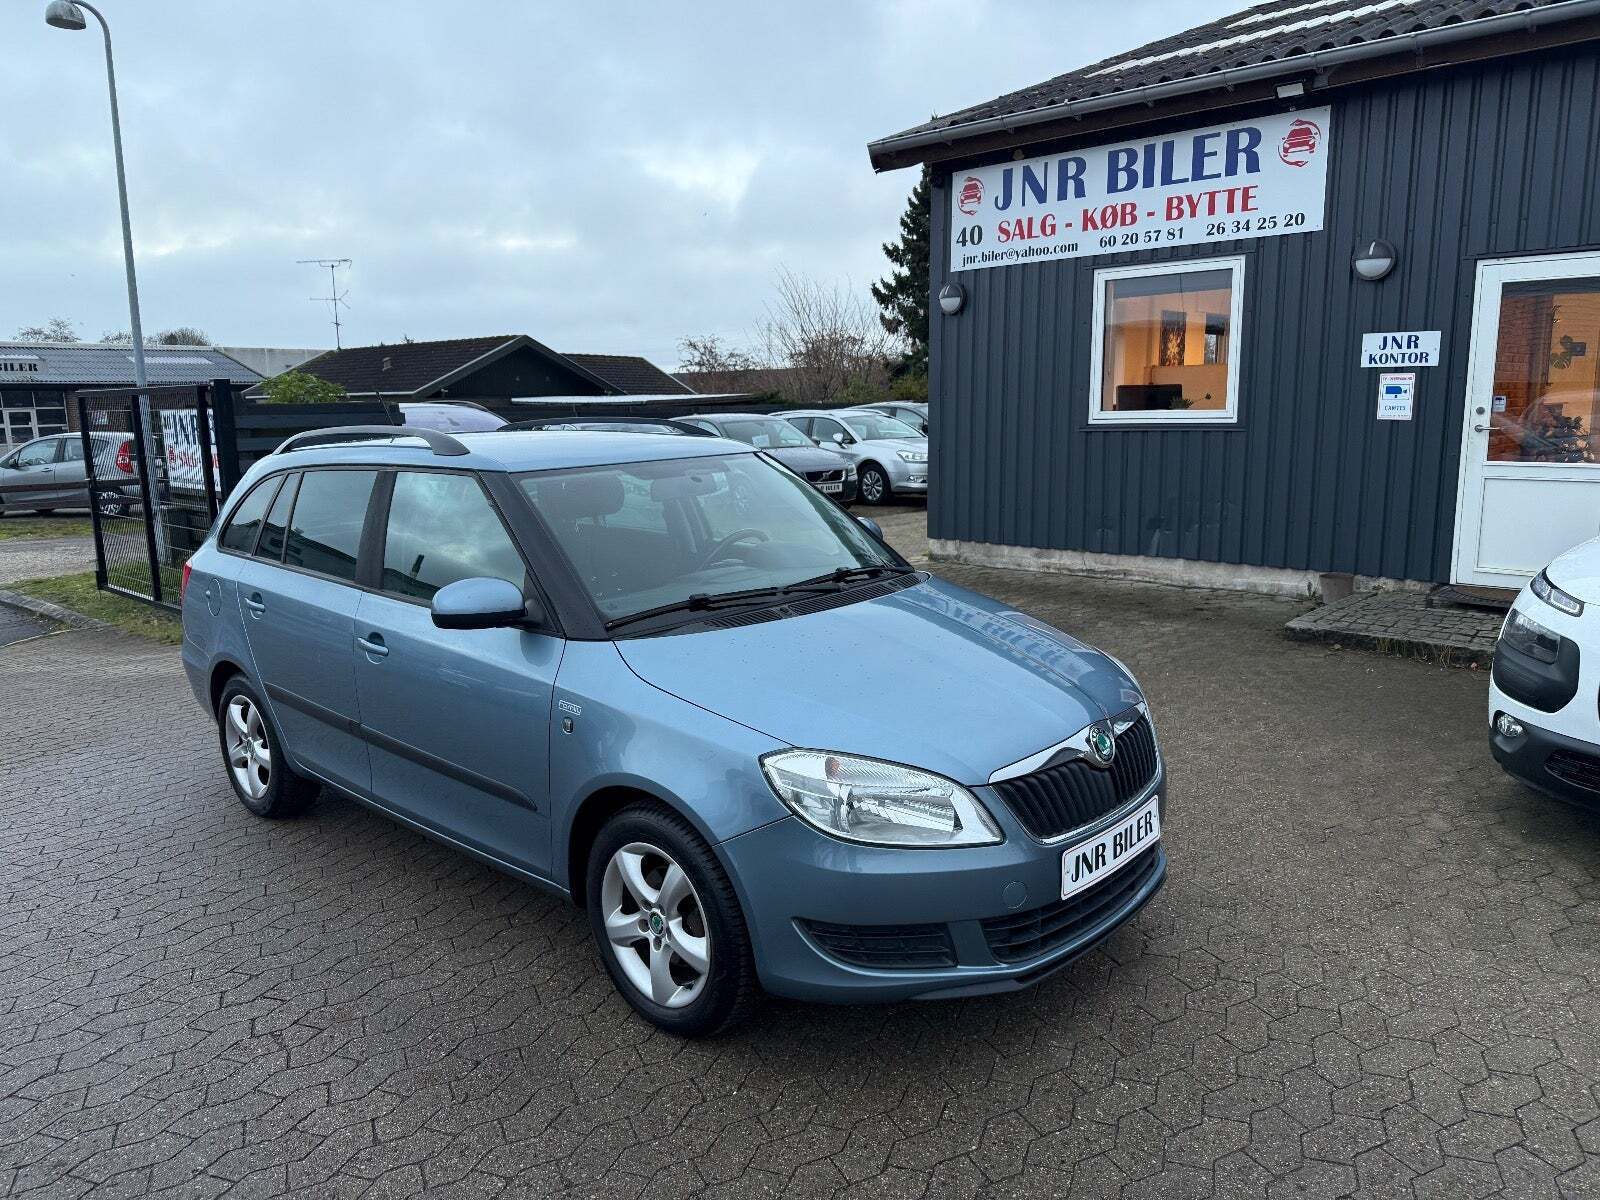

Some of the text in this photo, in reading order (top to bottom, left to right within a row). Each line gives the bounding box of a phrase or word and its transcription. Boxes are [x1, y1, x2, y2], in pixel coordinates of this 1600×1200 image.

[994, 126, 1262, 211] JNR BILER
[997, 213, 1056, 243] SALG
[1082, 202, 1137, 232] KØB
[1165, 185, 1259, 221] BYTTE
[1206, 211, 1306, 236] 26 34 25 20
[956, 224, 983, 248] 40
[1100, 226, 1184, 248] 60 20 57 81
[962, 242, 1079, 267] jnr.biler@yahoo.com
[1378, 334, 1420, 351] JNR
[1368, 352, 1430, 365] KONTOR
[1071, 810, 1154, 883] JNR BILER
